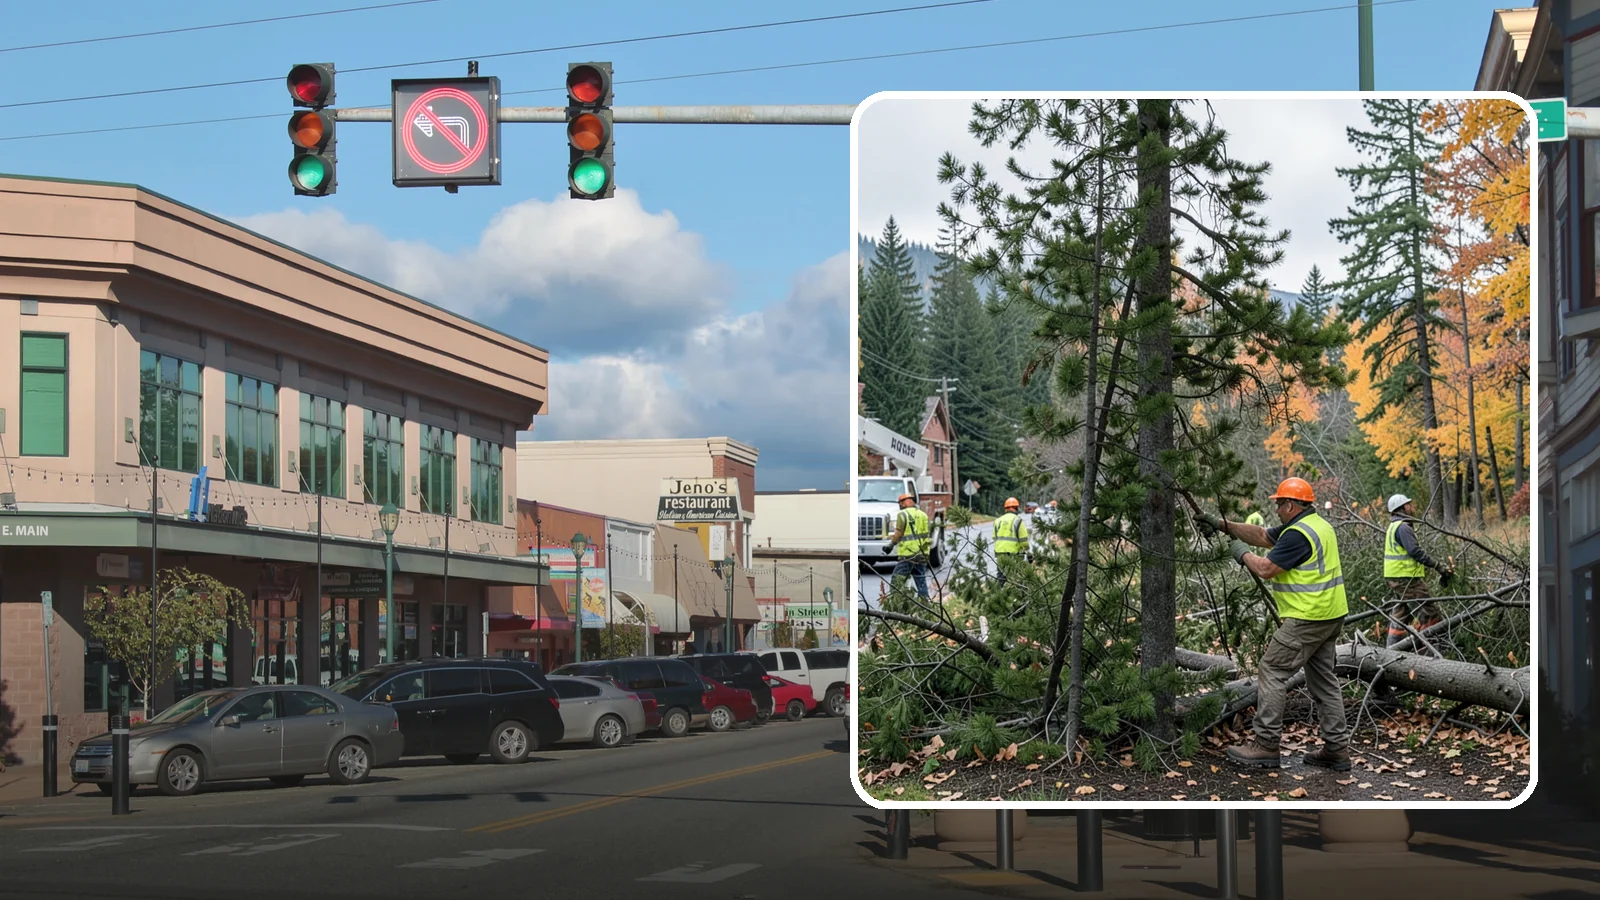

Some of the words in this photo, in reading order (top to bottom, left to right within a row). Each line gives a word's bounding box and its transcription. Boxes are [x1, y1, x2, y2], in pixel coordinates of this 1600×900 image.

[669, 480, 728, 494] Jeno's
[665, 496, 731, 509] restaurant
[658, 509, 682, 519] Italian
[685, 509, 714, 519] American
[714, 509, 737, 519] Cuisine
[2, 525, 13, 536] E.
[15, 525, 49, 536] MAIN
[797, 608, 828, 617] Street
